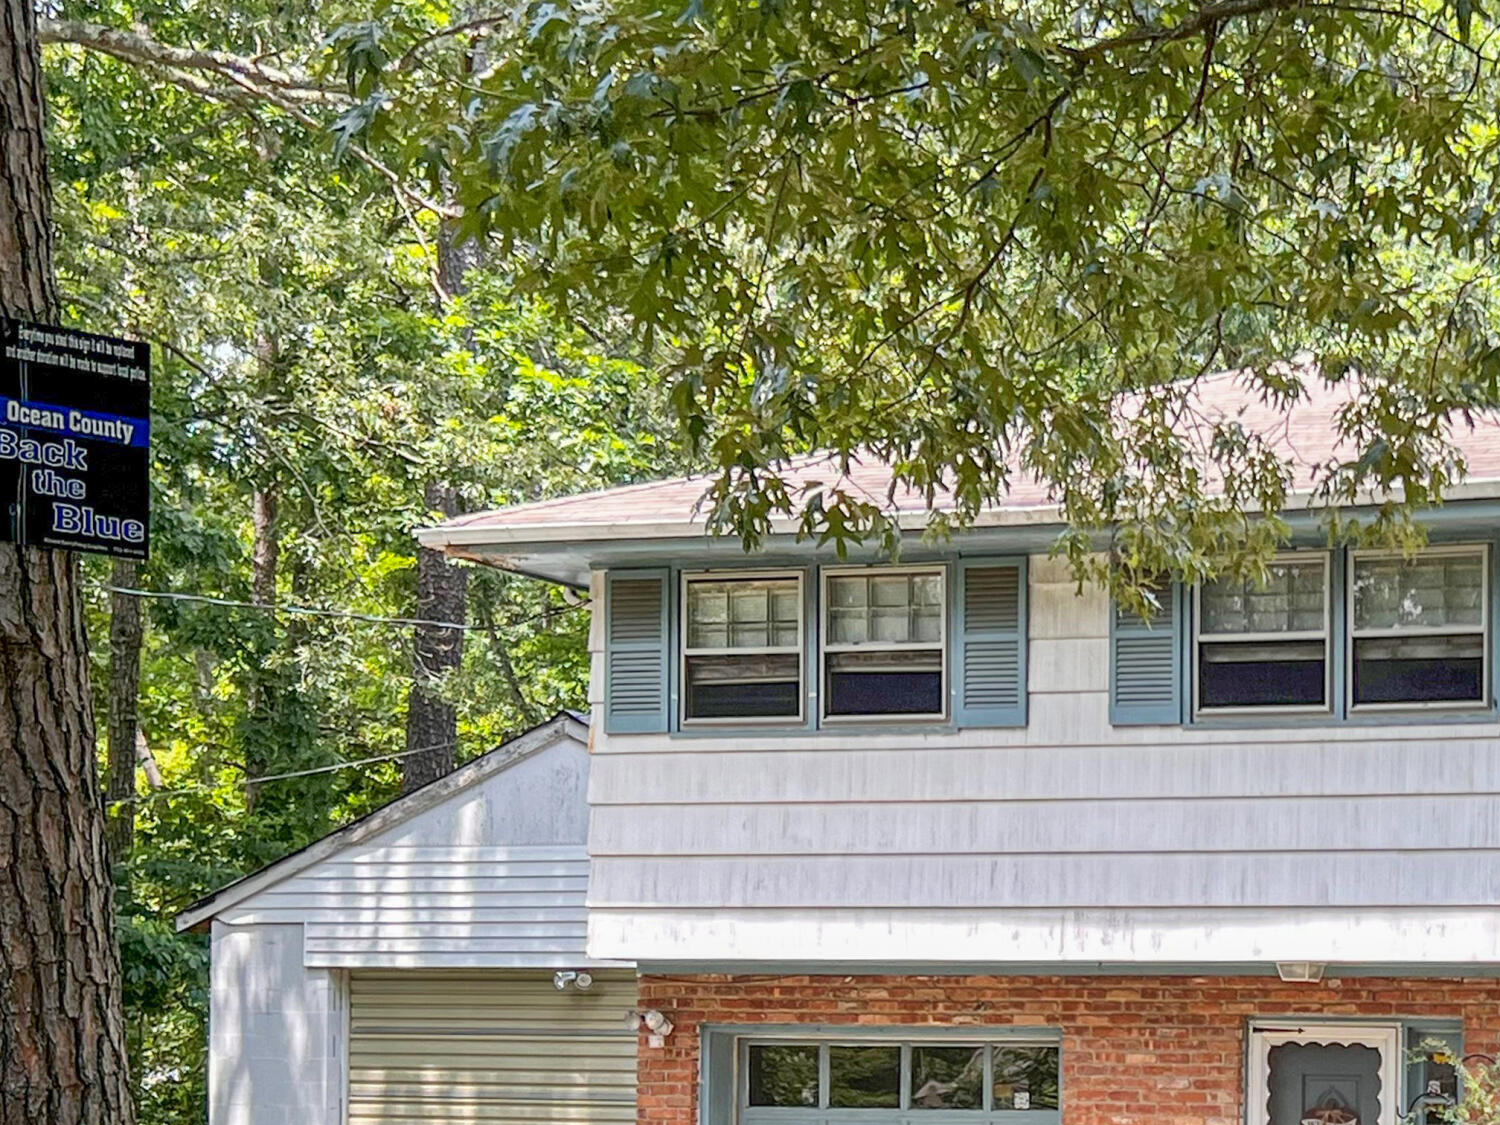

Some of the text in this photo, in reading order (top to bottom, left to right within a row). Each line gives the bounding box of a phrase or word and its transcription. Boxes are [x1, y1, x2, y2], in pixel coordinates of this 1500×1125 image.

[5, 344, 16, 358] and
[79, 336, 90, 354] sign
[7, 400, 134, 445] Ocean County
[0, 429, 88, 471] Back
[32, 470, 86, 499] the
[52, 502, 145, 542] Blue
